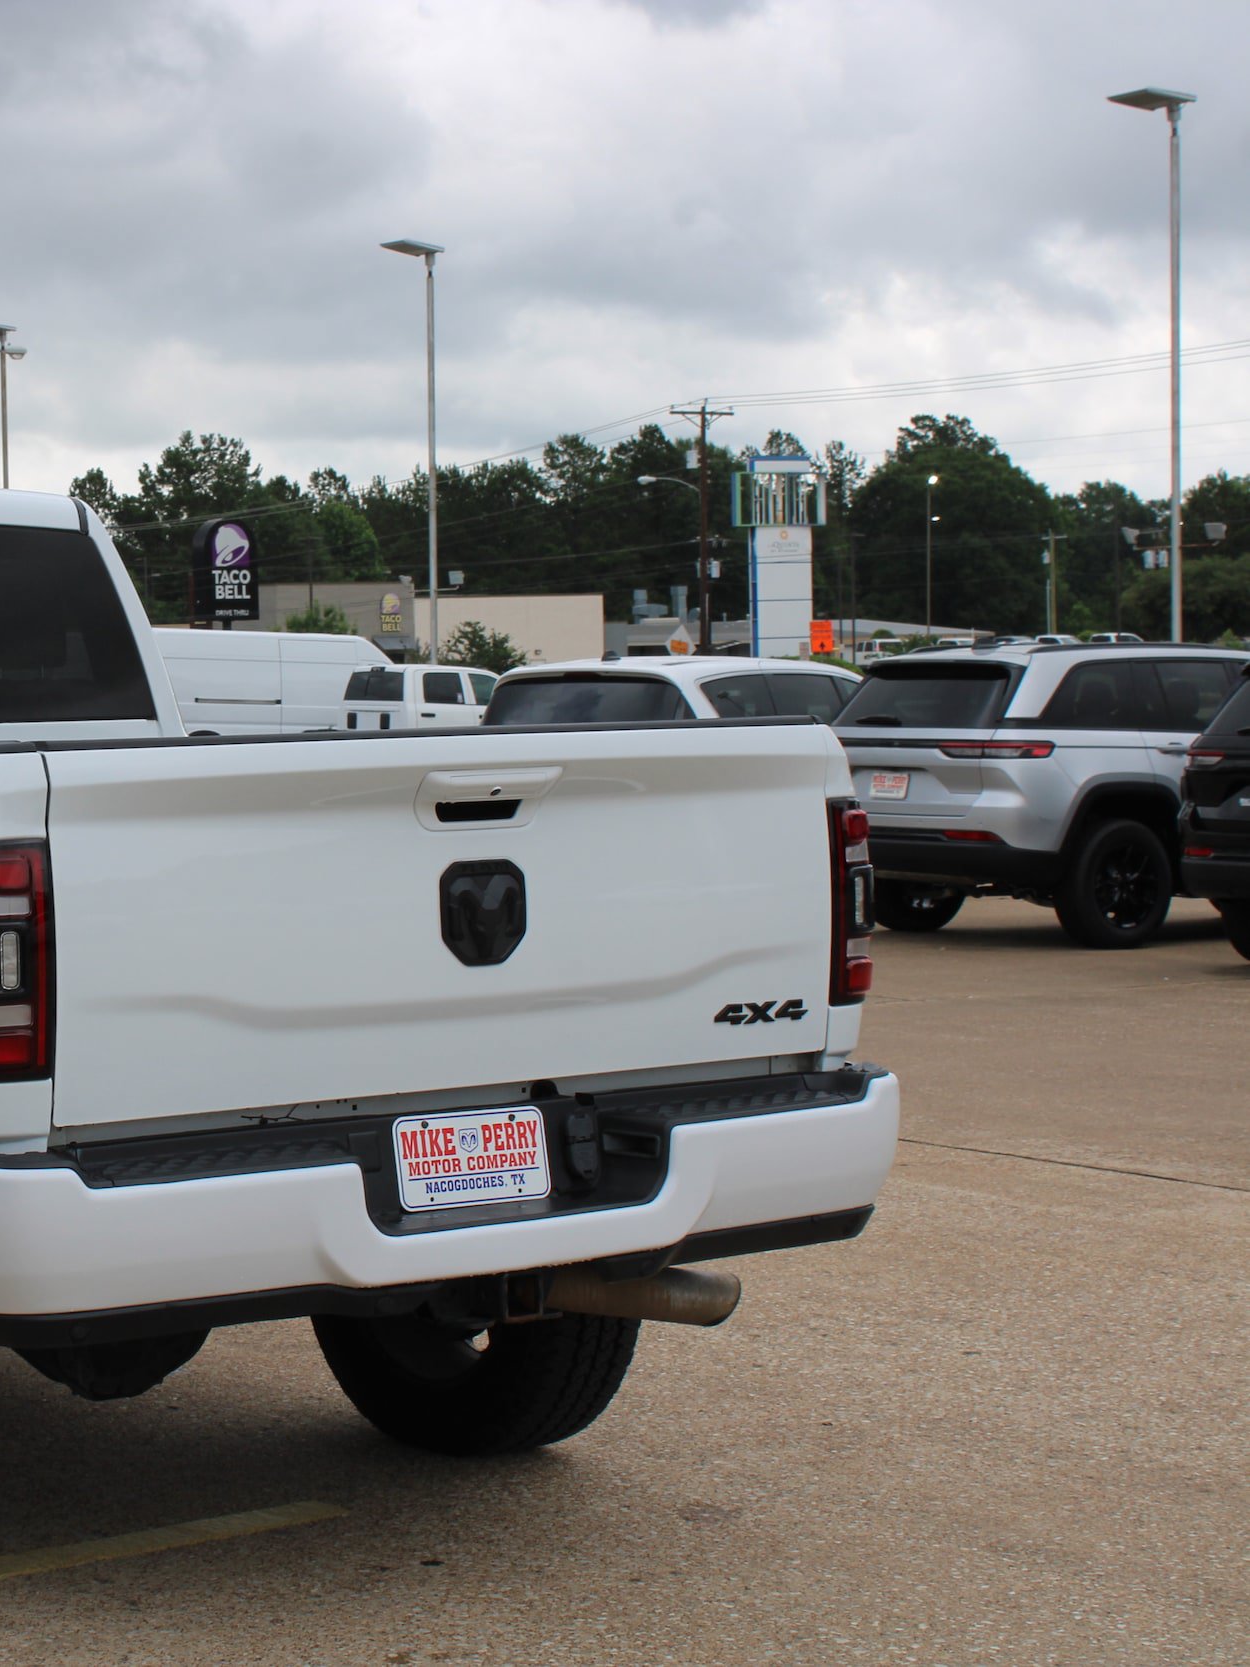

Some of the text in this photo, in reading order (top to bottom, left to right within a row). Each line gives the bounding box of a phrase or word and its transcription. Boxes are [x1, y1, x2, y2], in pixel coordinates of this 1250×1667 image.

[211, 569, 251, 584] TACO
[215, 585, 251, 600] BELL
[380, 614, 402, 623] TACO
[382, 623, 402, 632] BELL
[400, 1120, 538, 1159] MIKE PERRY
[408, 1151, 537, 1176] MOTOR COMPANY
[510, 1173, 526, 1186] TX
